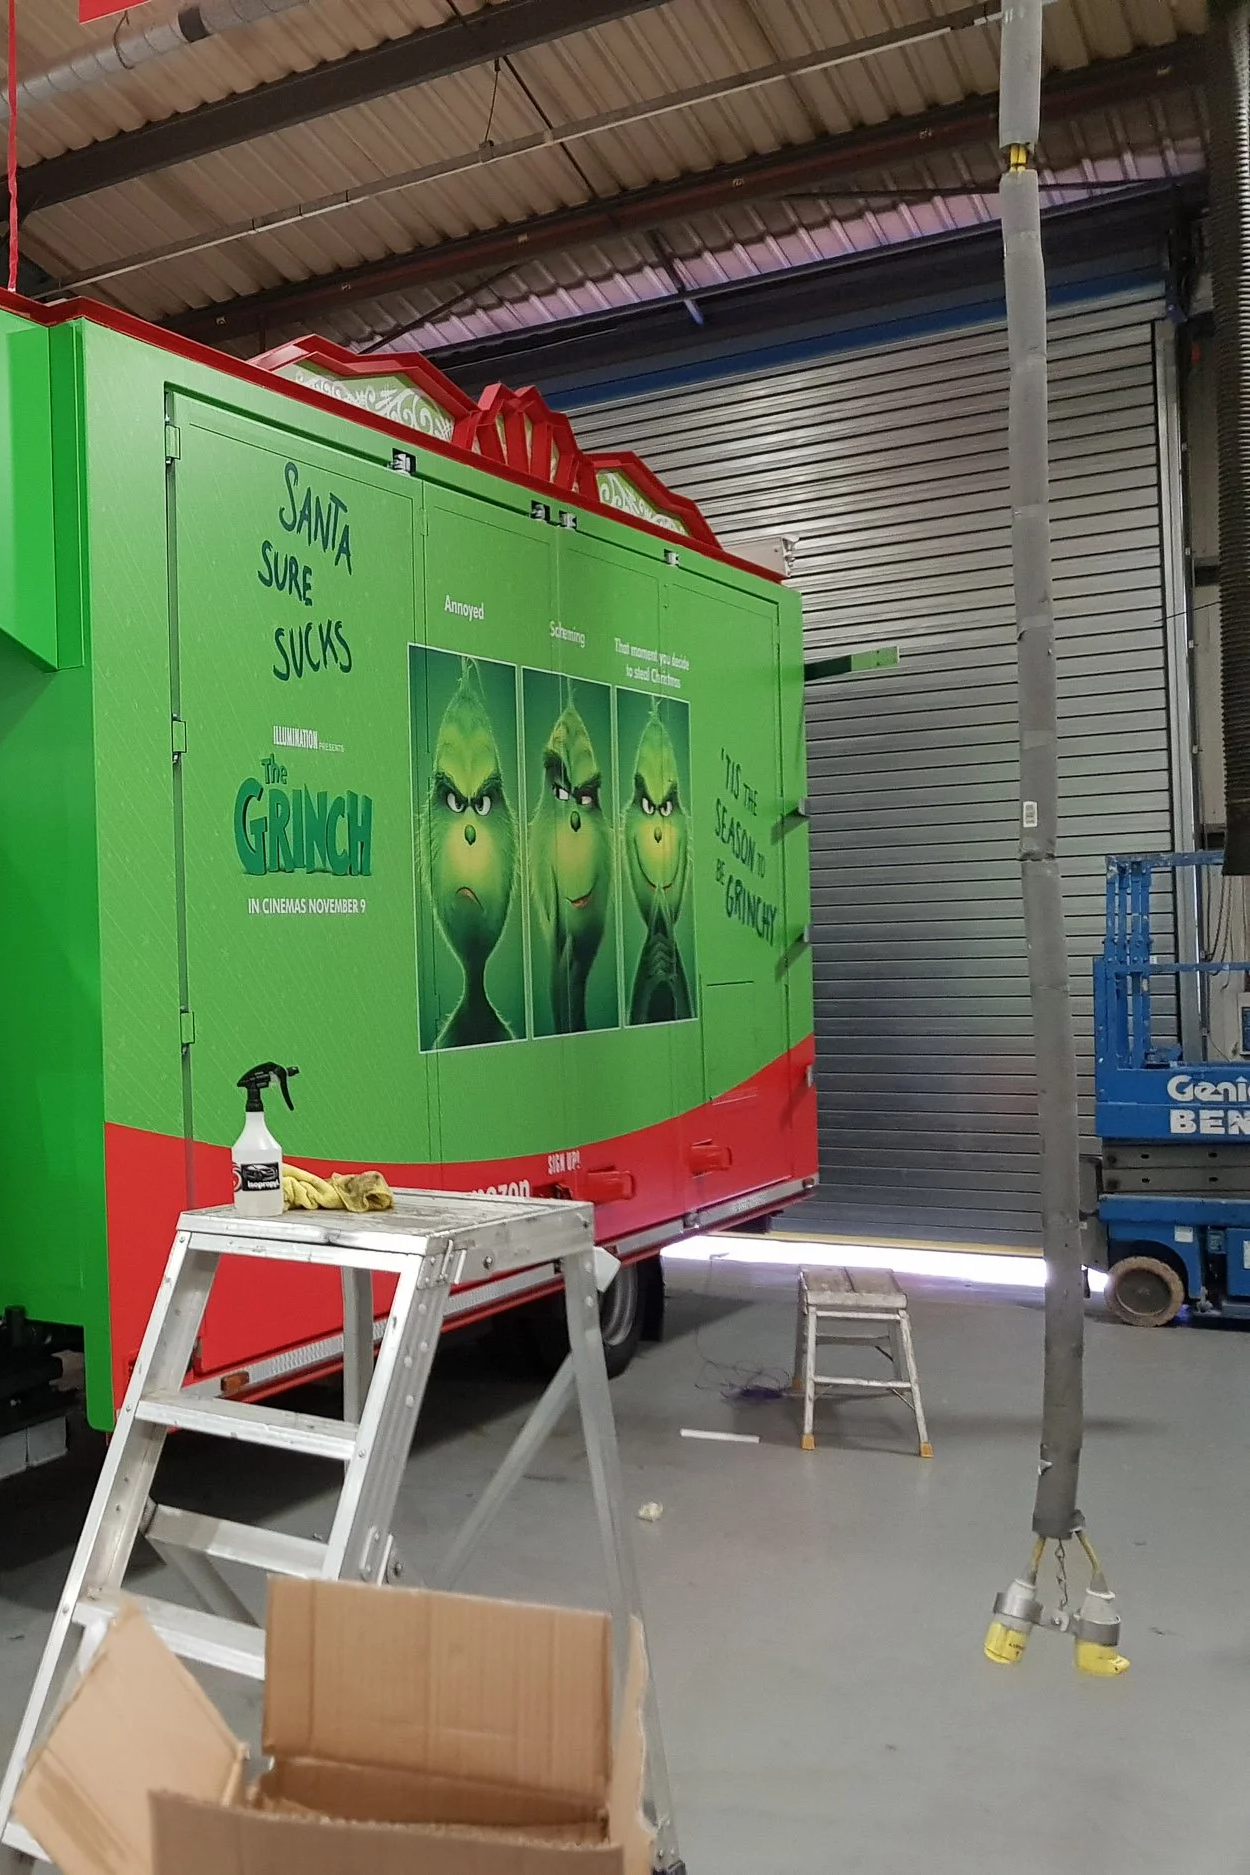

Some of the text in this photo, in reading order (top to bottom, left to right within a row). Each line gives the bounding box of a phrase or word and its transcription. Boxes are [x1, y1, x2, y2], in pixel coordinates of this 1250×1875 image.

[279, 462, 352, 575] SANTA
[258, 540, 313, 606] SURE
[445, 594, 485, 621] Annoyed
[550, 620, 586, 648] Scheming
[273, 620, 352, 681] SUCKS
[614, 637, 630, 655] That
[658, 652, 672, 668] you
[626, 664, 633, 678] to
[273, 725, 318, 749] ILLUMINATION
[261, 753, 287, 784] The
[743, 782, 758, 817] THE
[234, 777, 373, 876] GRINCH
[714, 798, 756, 874] SEASON
[248, 898, 367, 914] IN CINEMAS NOVEMBER 9
[715, 858, 778, 947] BE GRINCHY
[1167, 1075, 1250, 1102] Geni
[547, 1150, 582, 1176] SIGN UP!
